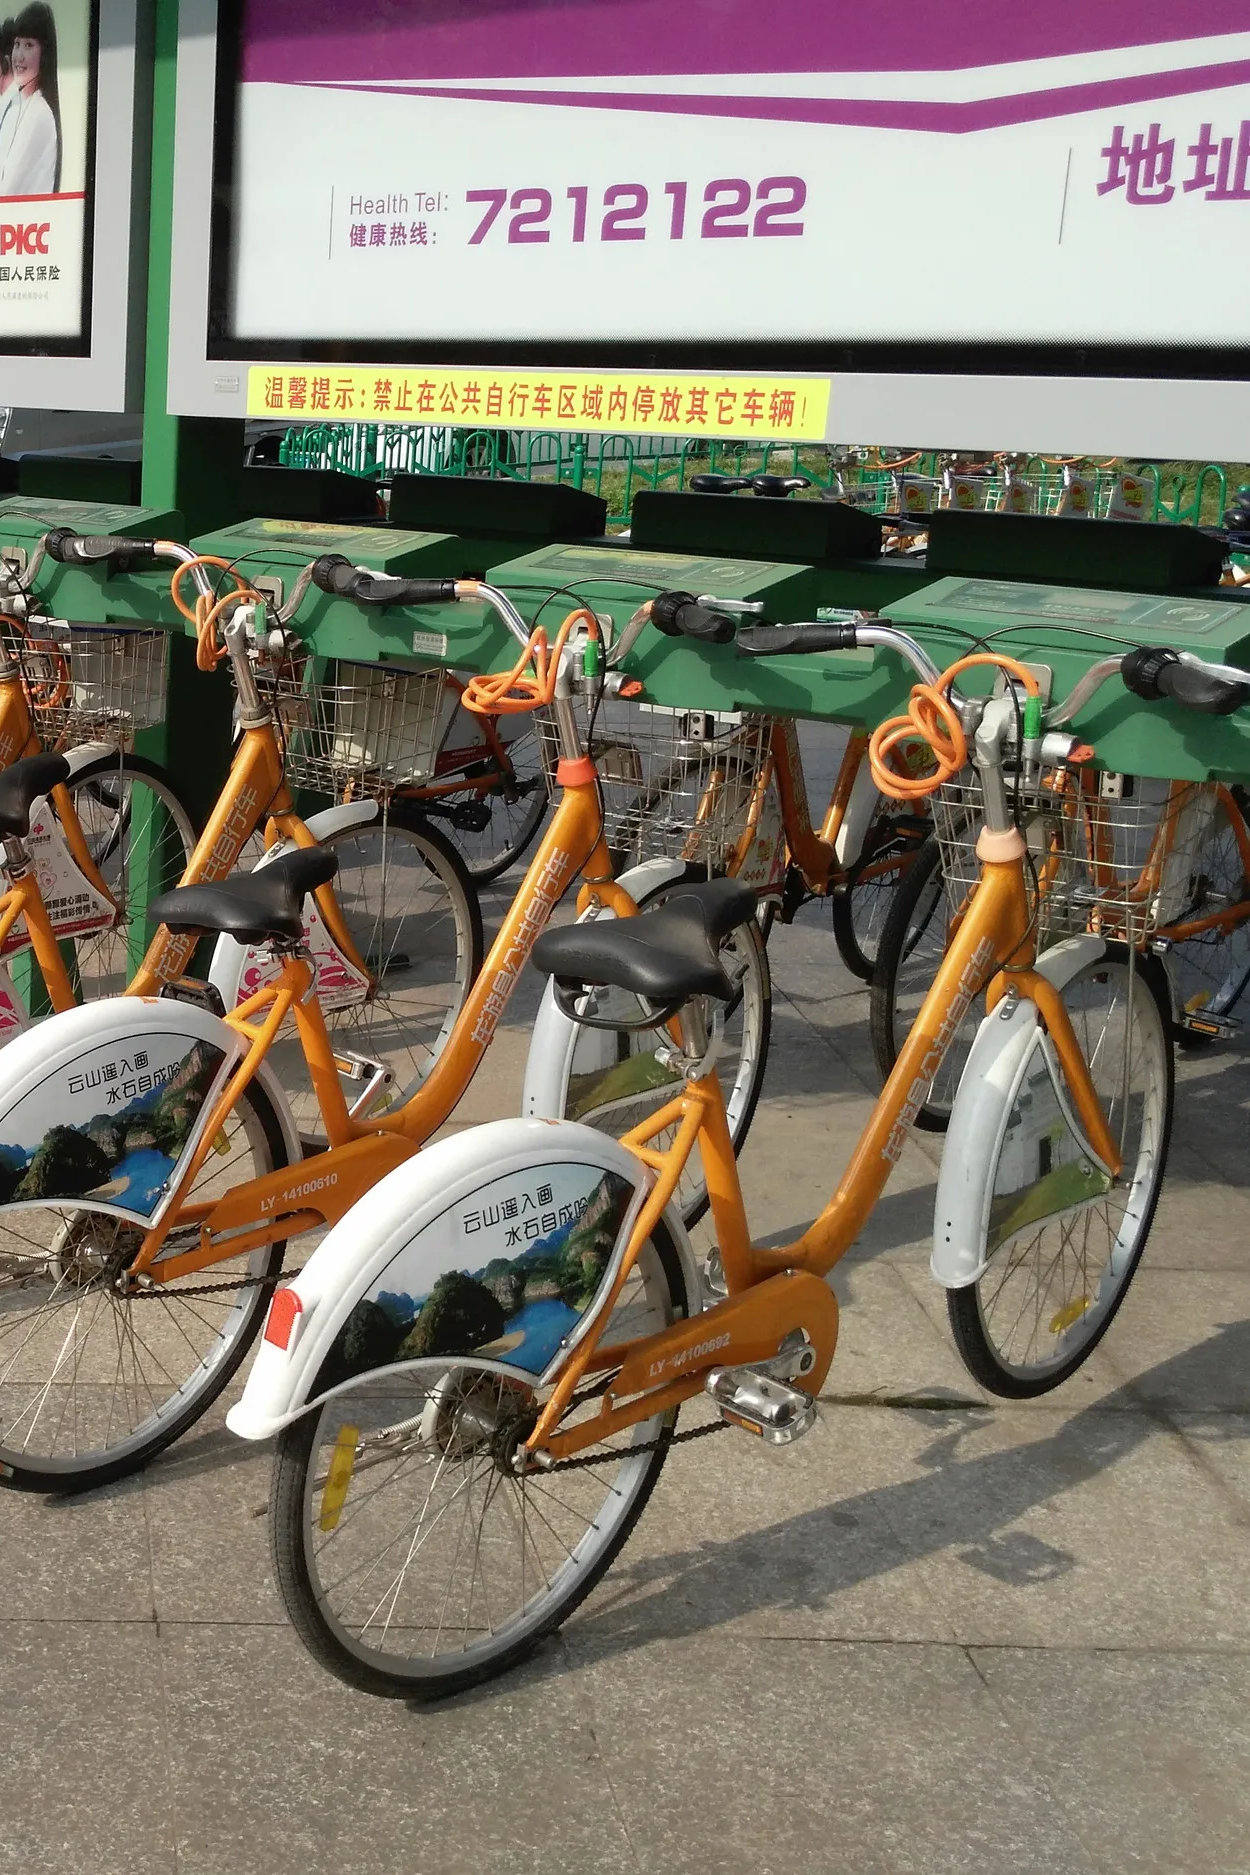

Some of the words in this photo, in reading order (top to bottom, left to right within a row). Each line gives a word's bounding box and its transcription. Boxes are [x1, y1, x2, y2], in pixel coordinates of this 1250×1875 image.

[350, 192, 408, 215] Health
[415, 190, 448, 213] Tel:
[465, 176, 806, 245] 7212122
[0, 222, 50, 255] PICC
[349, 221, 437, 247] 健康热线：
[264, 376, 808, 428] 温馨提示：禁止在公共自行车区域内停放其它车辆！
[67, 1049, 149, 1095] 云山遥入画
[260, 1172, 339, 1213] LY-14100610
[463, 1183, 553, 1235] 云山遥入画
